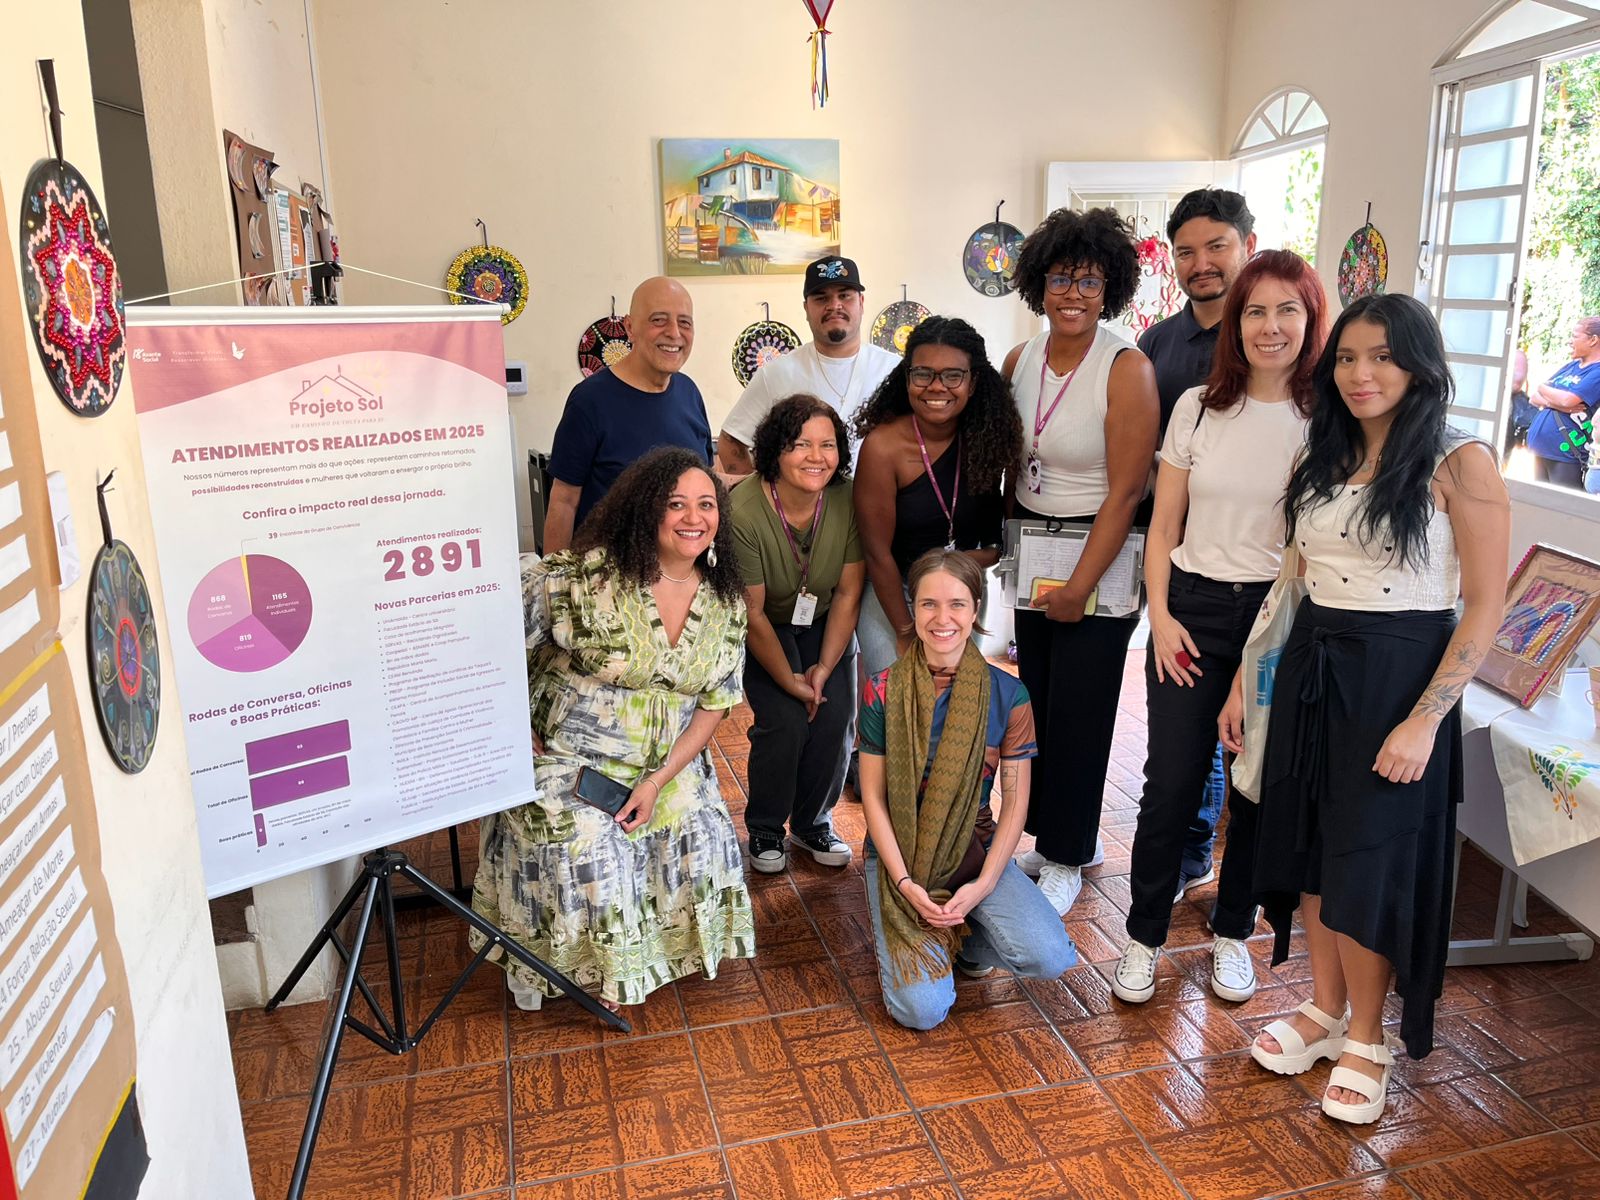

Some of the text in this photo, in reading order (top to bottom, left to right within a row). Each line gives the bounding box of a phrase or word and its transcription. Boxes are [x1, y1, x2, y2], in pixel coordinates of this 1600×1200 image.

[289, 396, 383, 418] Projeto Sol
[171, 424, 485, 464] ATENDIMENTOS REALIZADOS EM 2025
[183, 472, 213, 482] Nossos
[214, 467, 249, 478] números
[250, 464, 298, 476] representam
[299, 461, 317, 470] mais
[318, 461, 328, 469] do
[329, 460, 343, 468] que
[367, 454, 409, 464] representam
[409, 450, 441, 460] caminhos
[192, 483, 250, 496] possibilidades
[251, 477, 304, 490] reconstruídas
[311, 473, 344, 483] mulheres
[344, 472, 359, 481] que
[359, 468, 389, 479] voltaram
[430, 462, 453, 471] próprio
[242, 488, 446, 520] Confira o impacto real dessa jornada.
[268, 532, 278, 540] 39
[376, 527, 482, 548] Atendimentos realizados:
[383, 538, 482, 582] 2891
[272, 592, 288, 601] 1165
[374, 582, 501, 612] Novas Parcerias em 2025:
[239, 634, 252, 642] 819
[188, 679, 352, 723] Rodas de Conversa, Oficinas
[230, 698, 321, 727] e Boas Práticas:
[12, 704, 39, 741] Prender
[0, 747, 53, 816] çar com Objetos
[24, 822, 38, 847] com
[38, 797, 58, 830] Armas
[0, 849, 64, 942] Ameaçar de Morte
[6, 954, 32, 997] Forçar
[29, 918, 57, 962] Relação
[56, 885, 78, 924] Sexual
[8, 1036, 21, 1064] 25
[25, 999, 50, 1039] Abuso
[50, 954, 74, 1002] Sexual
[18, 1086, 31, 1116] 26
[35, 1024, 70, 1086] Violentar
[24, 1138, 36, 1170] 27
